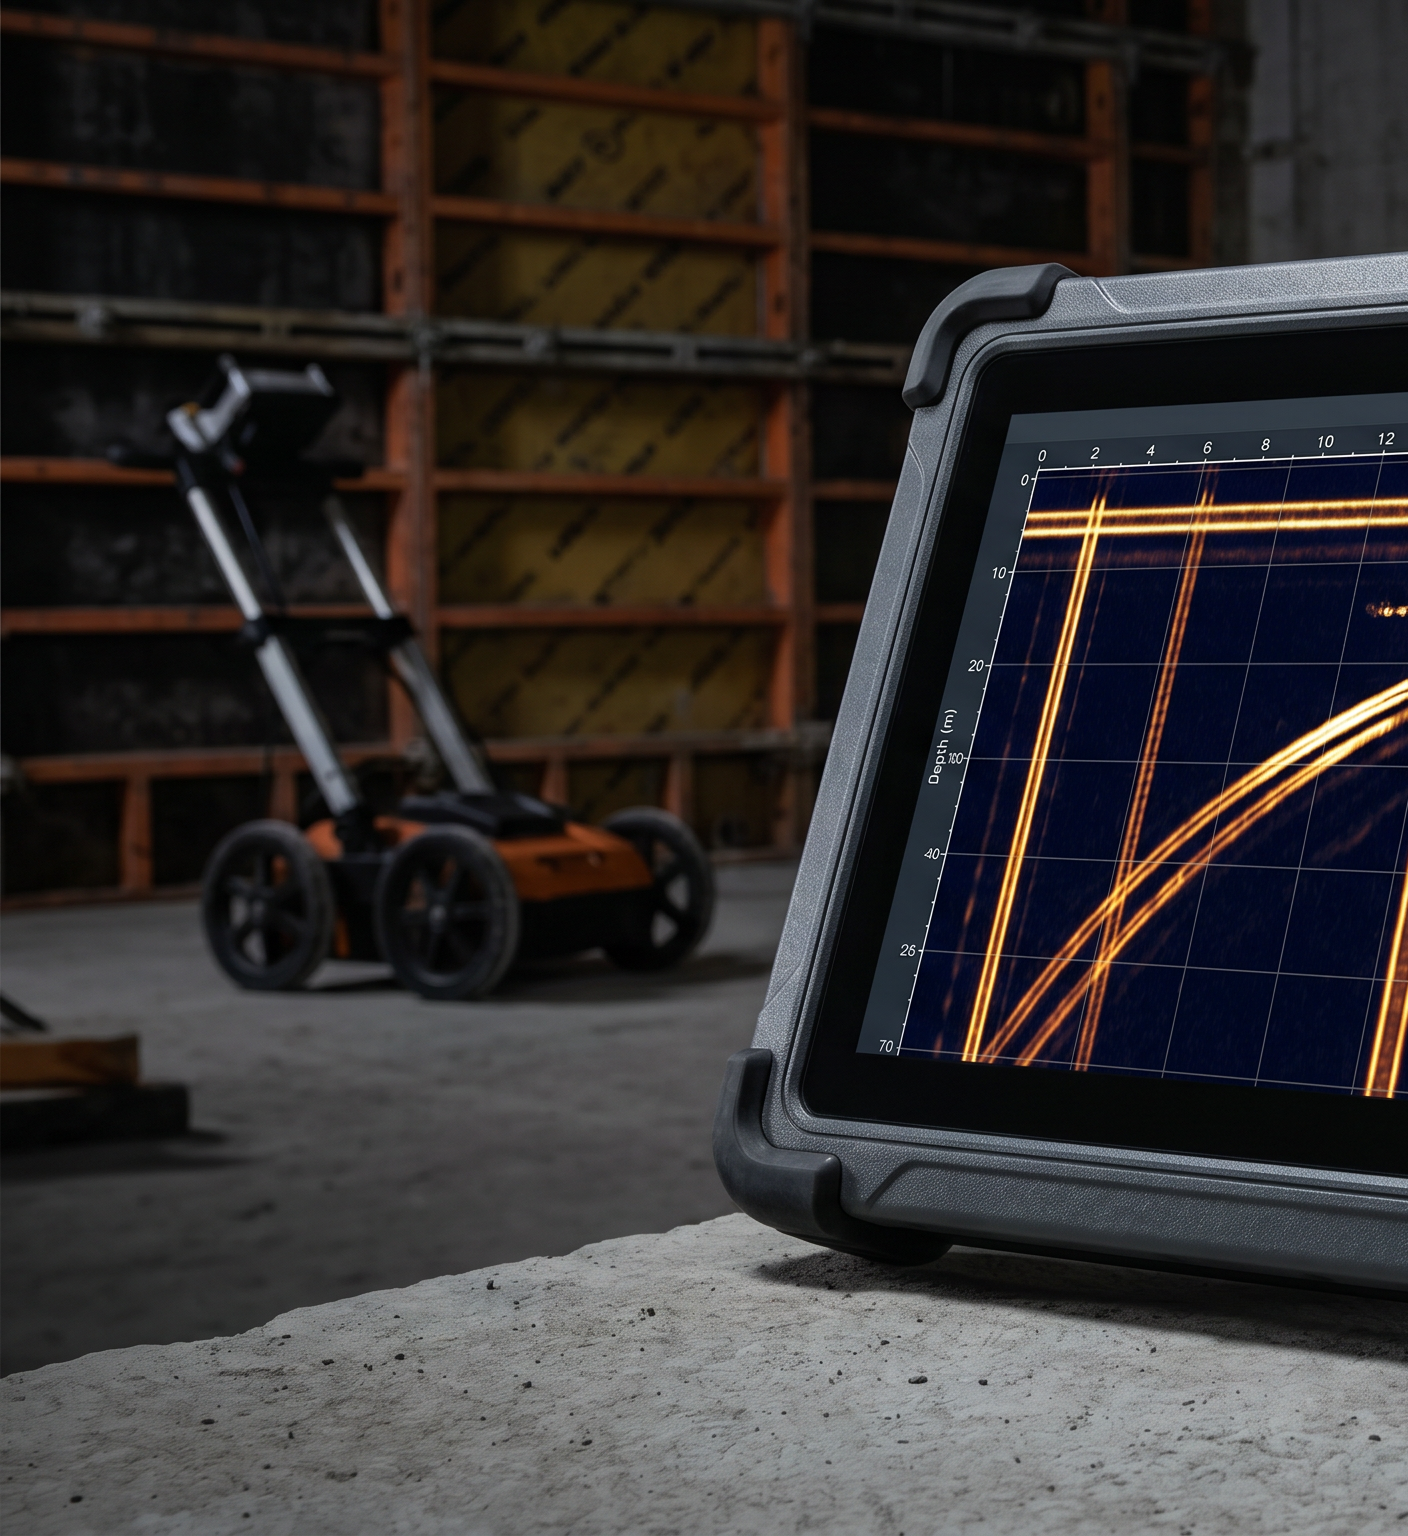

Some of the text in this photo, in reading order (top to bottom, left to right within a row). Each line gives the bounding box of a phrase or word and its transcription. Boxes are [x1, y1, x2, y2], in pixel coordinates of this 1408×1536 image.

[1037, 449, 1047, 462] 0
[1090, 446, 1100, 460] 2
[1145, 444, 1156, 458] 4
[1202, 440, 1213, 455] 6
[1260, 438, 1271, 452] 8
[1317, 434, 1335, 449] 10
[1377, 431, 1396, 446] 12
[1020, 473, 1030, 487] 0
[991, 566, 1007, 580] 10
[967, 659, 984, 672] 20
[927, 709, 958, 785] Depth (m)
[923, 847, 941, 860] 40
[879, 1039, 894, 1053] 70
